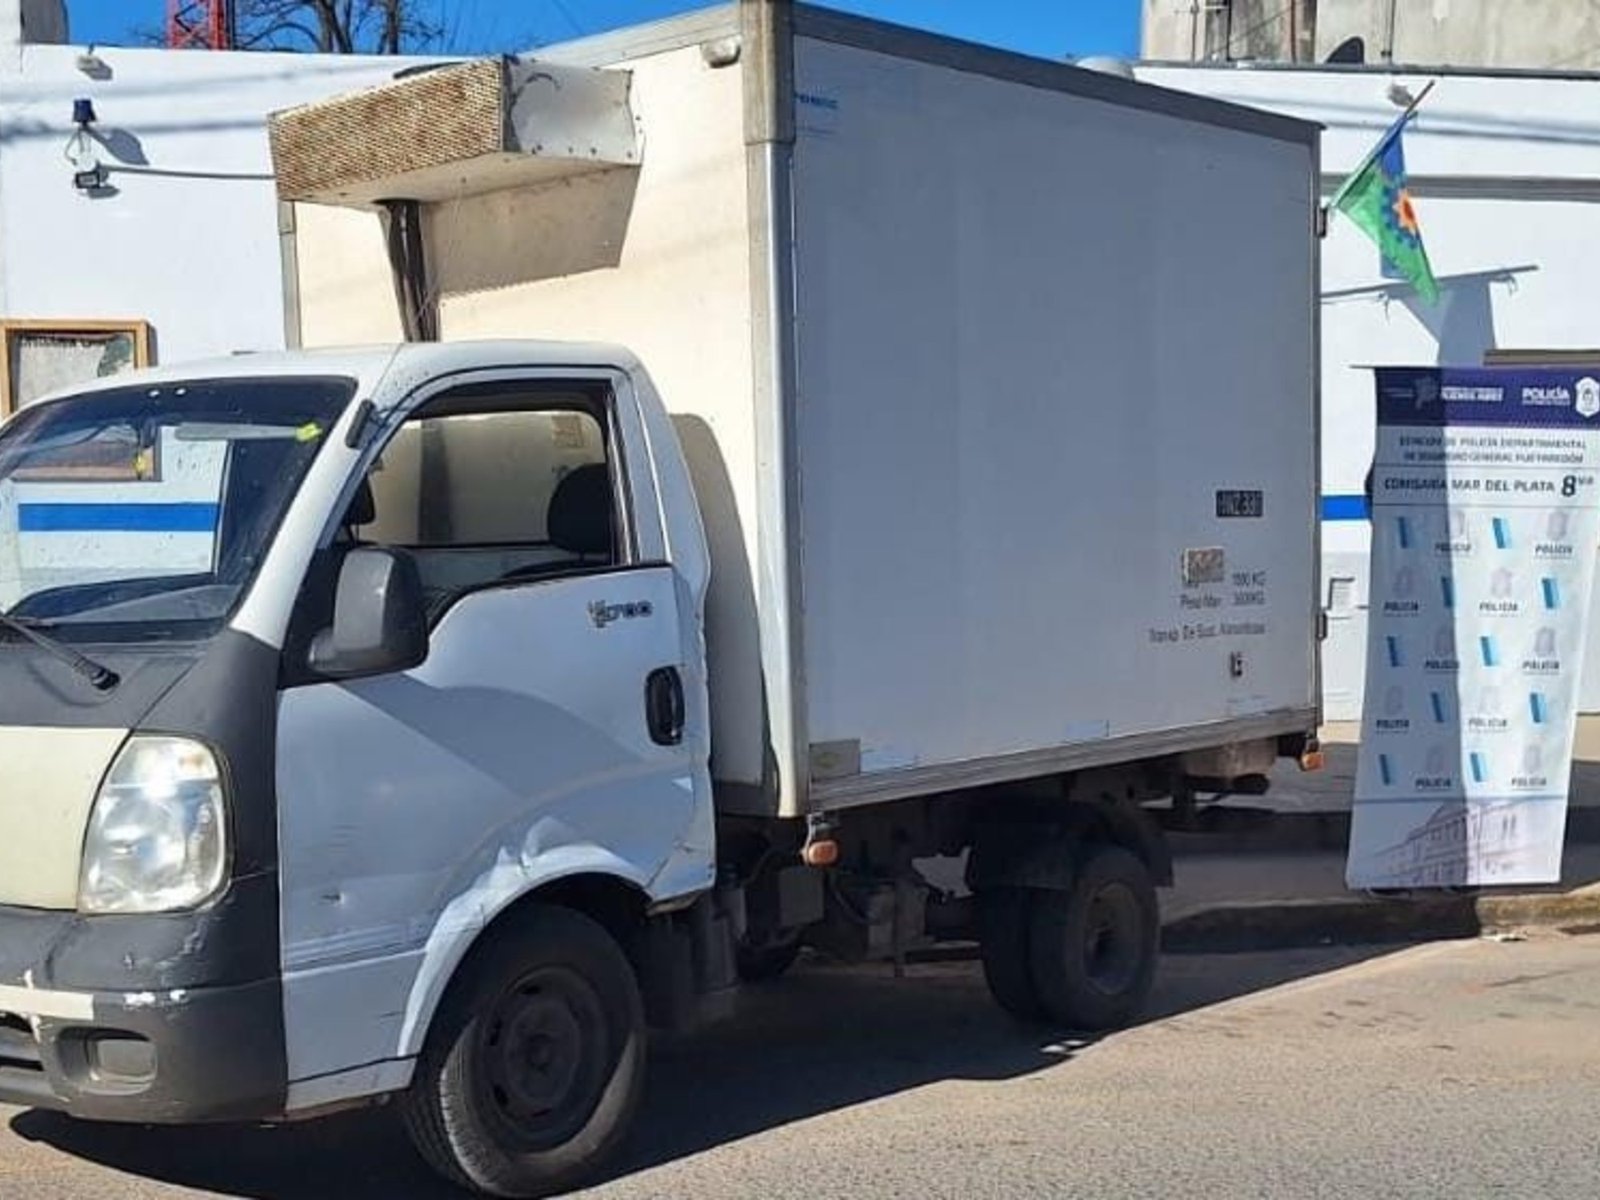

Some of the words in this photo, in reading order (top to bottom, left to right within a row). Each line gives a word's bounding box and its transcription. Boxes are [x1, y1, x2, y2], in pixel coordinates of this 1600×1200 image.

[1452, 479, 1481, 490] MAR
[1485, 480, 1510, 491] DEL
[1514, 480, 1555, 492] PLATA
